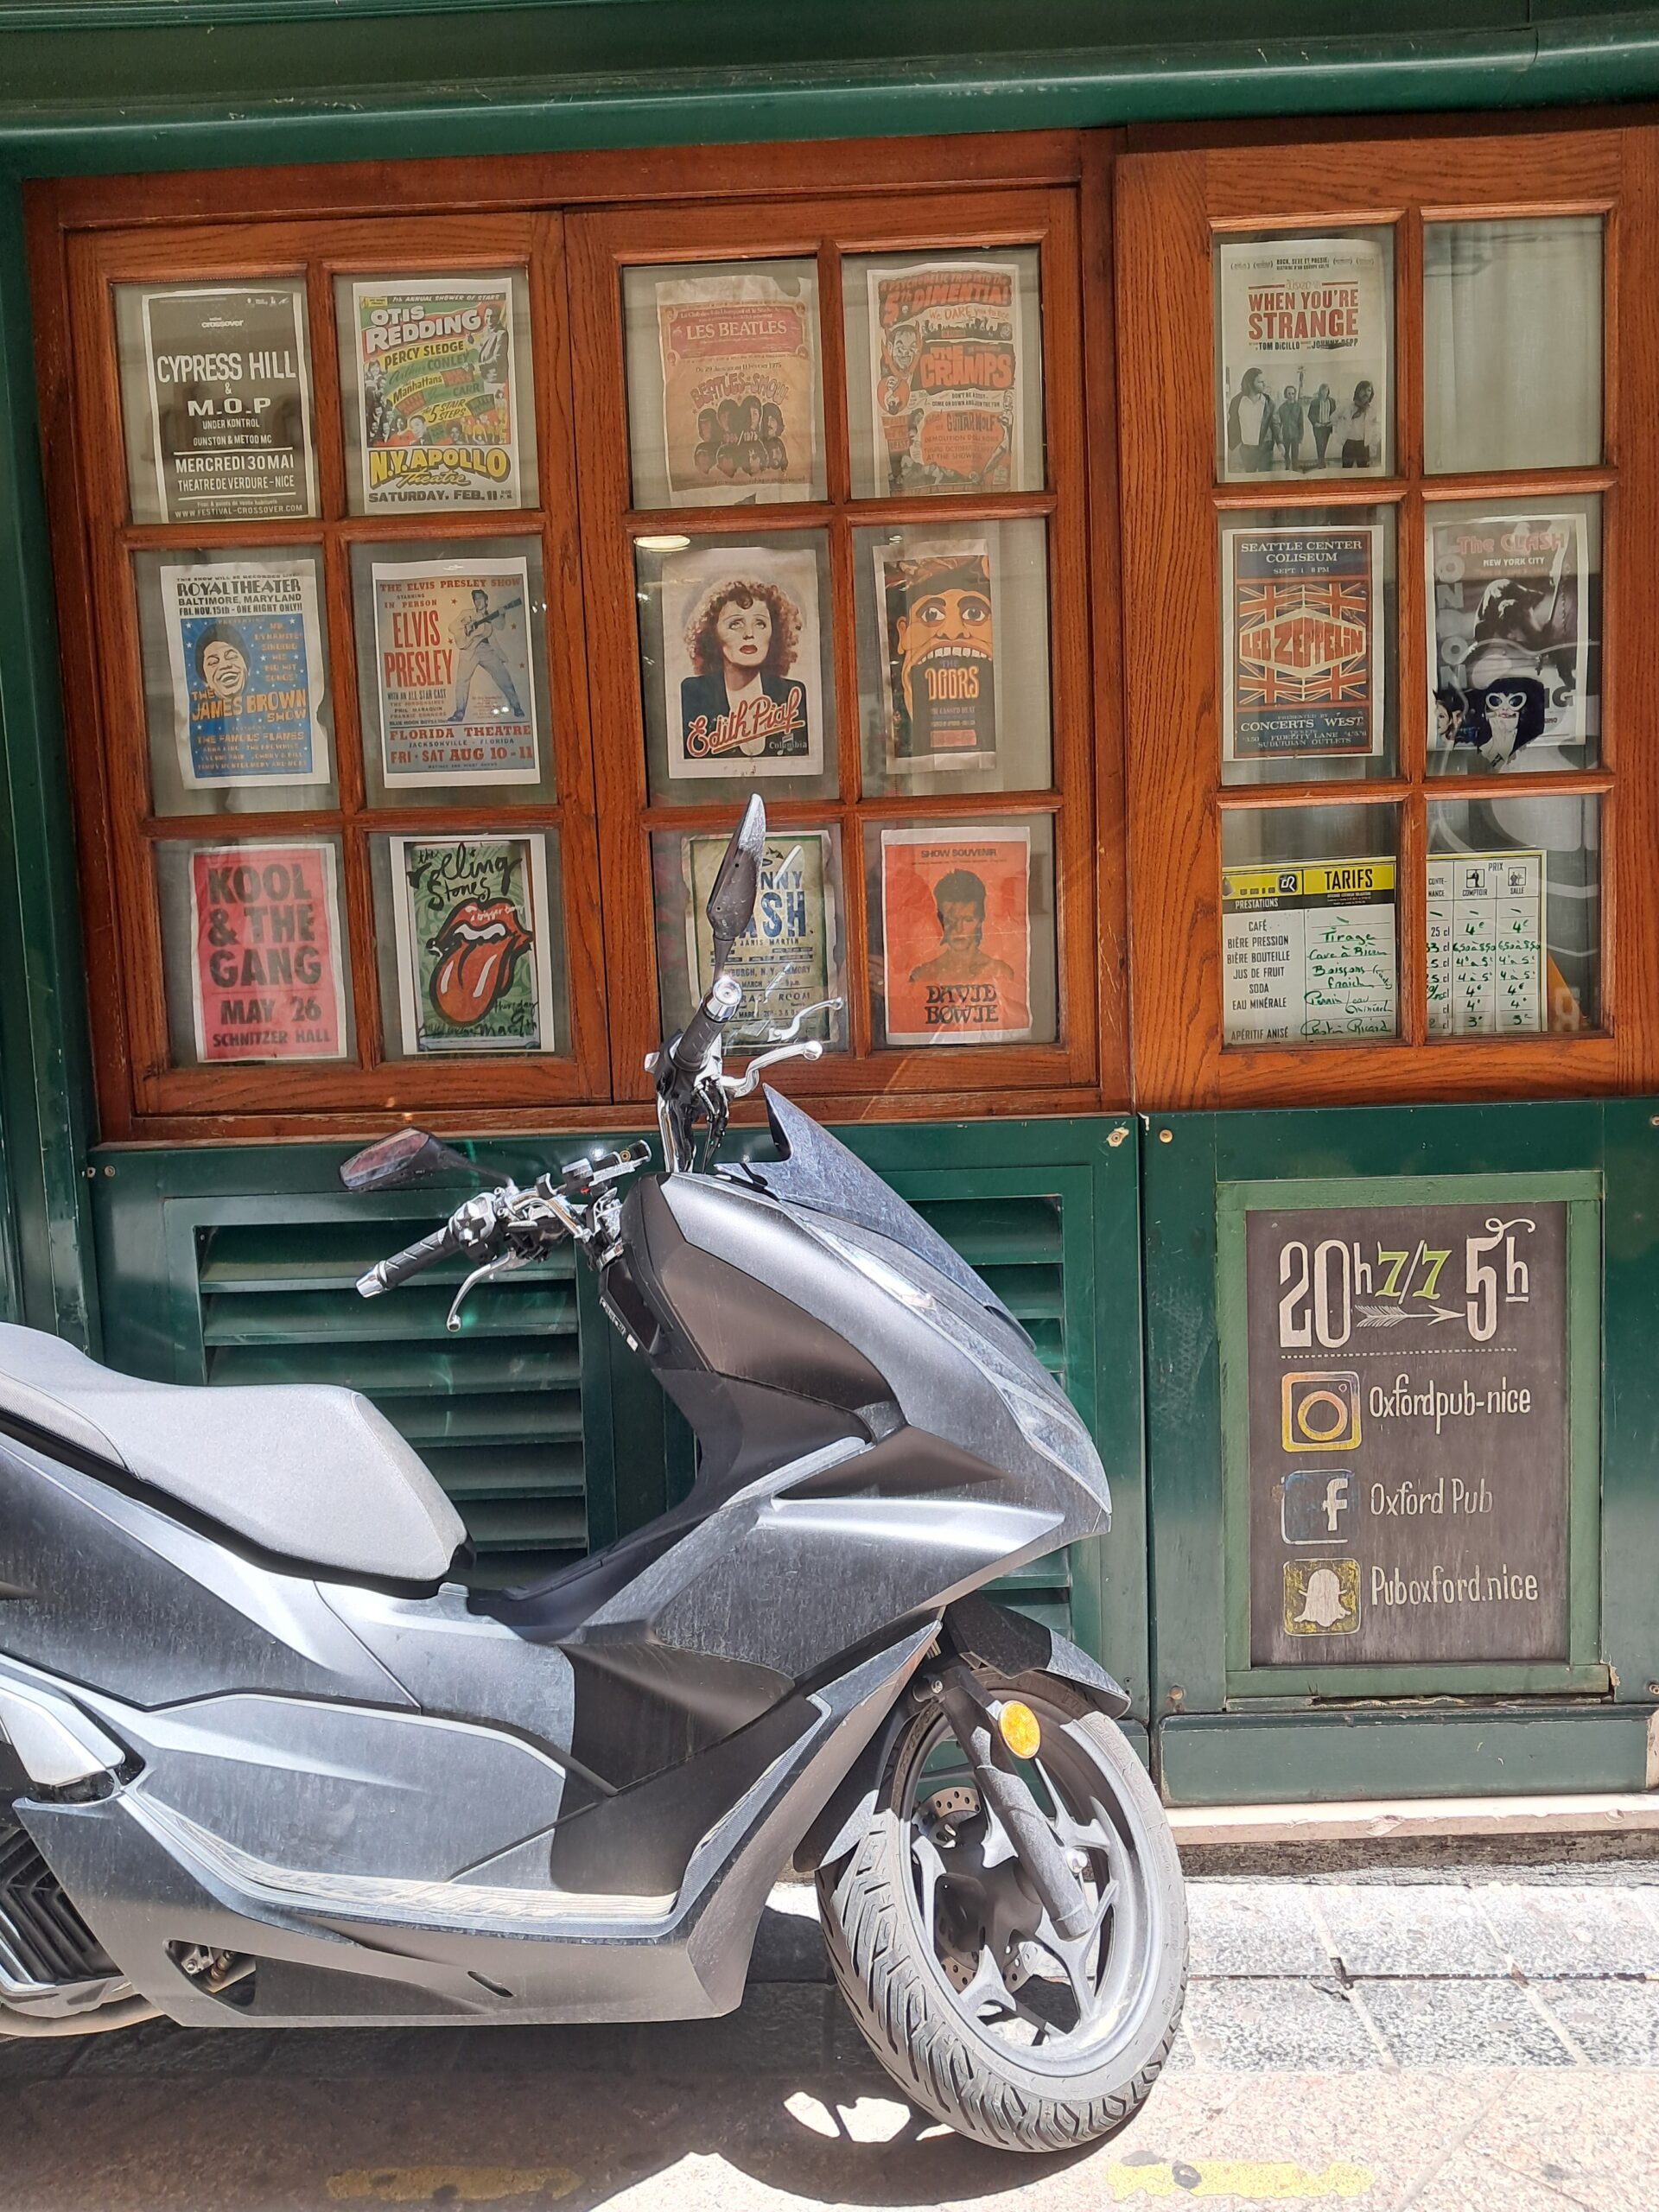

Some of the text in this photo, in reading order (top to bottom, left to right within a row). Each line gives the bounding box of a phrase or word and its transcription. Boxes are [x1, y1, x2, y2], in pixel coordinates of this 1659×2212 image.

[1249, 289, 1358, 312] WHEN YOU'RE
[371, 305, 425, 326] OTIS
[945, 308, 972, 320] DARE
[365, 309, 481, 354] REDDING
[687, 321, 787, 340] LES BEATLES
[1249, 308, 1358, 340] STRANGE
[385, 340, 464, 370] PERCY SLEDGE
[931, 346, 963, 359] THE
[1259, 342, 1274, 351] TOM
[157, 351, 296, 383] CYPRESS HILL
[427, 352, 471, 371] CONLEY
[921, 353, 1012, 389] CRAMPS
[225, 382, 232, 395] &
[393, 375, 442, 404] Manhattans
[188, 397, 271, 416] M.O.P
[429, 404, 440, 423] 5
[441, 399, 467, 411] STAIR
[438, 408, 467, 421] STEPS
[202, 418, 260, 429] UNDER KONTROL
[227, 434, 272, 445] & METOD MC
[175, 454, 294, 474] MERCREDI 30 MAI
[410, 448, 511, 482] APOLLO
[178, 475, 295, 492] THEATRE DE VERDURE NICE
[397, 469, 471, 489] Theatre
[454, 489, 497, 501] FEB. 11
[1241, 540, 1363, 553] SEATTLE CENTER
[1457, 531, 1566, 555] The CLASH
[1266, 553, 1338, 563] COLISEUM
[1503, 558, 1526, 567] YORK
[1528, 556, 1545, 565] CITY
[177, 578, 301, 597] ROYAL THEATER
[380, 577, 523, 593] THE ELVIS PRESLEY SHOW
[178, 593, 302, 607] BALTIMORE, MARYLAND
[195, 603, 276, 615] NOV. ONE NIGHT
[392, 610, 441, 649] ELVIS
[1242, 628, 1272, 661] LED
[384, 650, 453, 688] PRESLEY
[925, 666, 980, 701] DOORS
[192, 691, 215, 701] THE
[408, 689, 446, 700] ALL STAR CAST
[192, 689, 306, 721] JAMES BROWN
[267, 709, 306, 722] SHOW
[688, 687, 802, 757] Edith Piaf
[389, 724, 531, 741] FLORIDA THEATRE
[1241, 717, 1363, 732] CONCERTS WEST
[198, 732, 304, 744] THE FAMOUS FLAMES
[410, 740, 467, 748] JACKSONVILLE
[391, 747, 533, 764] FRI SAT AUG 10 11
[417, 849, 439, 864] the
[921, 849, 997, 859] SHOW SOUVENIR
[1488, 862, 1503, 873] PRIX
[207, 863, 311, 905] KOOL
[1325, 868, 1373, 891] TARIFS
[1462, 888, 1488, 897] COMPTOIR
[1236, 898, 1279, 910] PRESTATIONS
[207, 904, 315, 947] & THE
[1249, 919, 1267, 931] CAFÉ
[1431, 926, 1450, 937] 25 cl
[741, 938, 764, 947] JANIS
[1227, 935, 1289, 949] BIÈRE PRESSION
[1319, 927, 1376, 945] Tirage
[1443, 942, 1449, 952] cl
[1227, 950, 1290, 964] BIÈRE BOUTEILLE
[209, 945, 321, 988] GANG
[1233, 966, 1285, 980] JUS DE FRUIT
[779, 992, 810, 1001] ROOM
[926, 983, 997, 1004] DAVID
[1249, 983, 1270, 994] SODA
[221, 995, 321, 1025] MAY 26
[1232, 995, 1287, 1011] EAU MINÉRALE
[925, 1004, 999, 1025] BOWIE
[1231, 1025, 1289, 1042] APÉRITIF ANISÉ
[1347, 1018, 1392, 1035] Ricard
[213, 1029, 332, 1047] SCHNITZER HALL
[1279, 1217, 1536, 1349] 20h 7/7 5h
[1369, 1372, 1531, 1434] Oxfordpub-nice
[1370, 1478, 1493, 1516] Oxford Pub
[1371, 1564, 1538, 1607] Puboxford.nice
